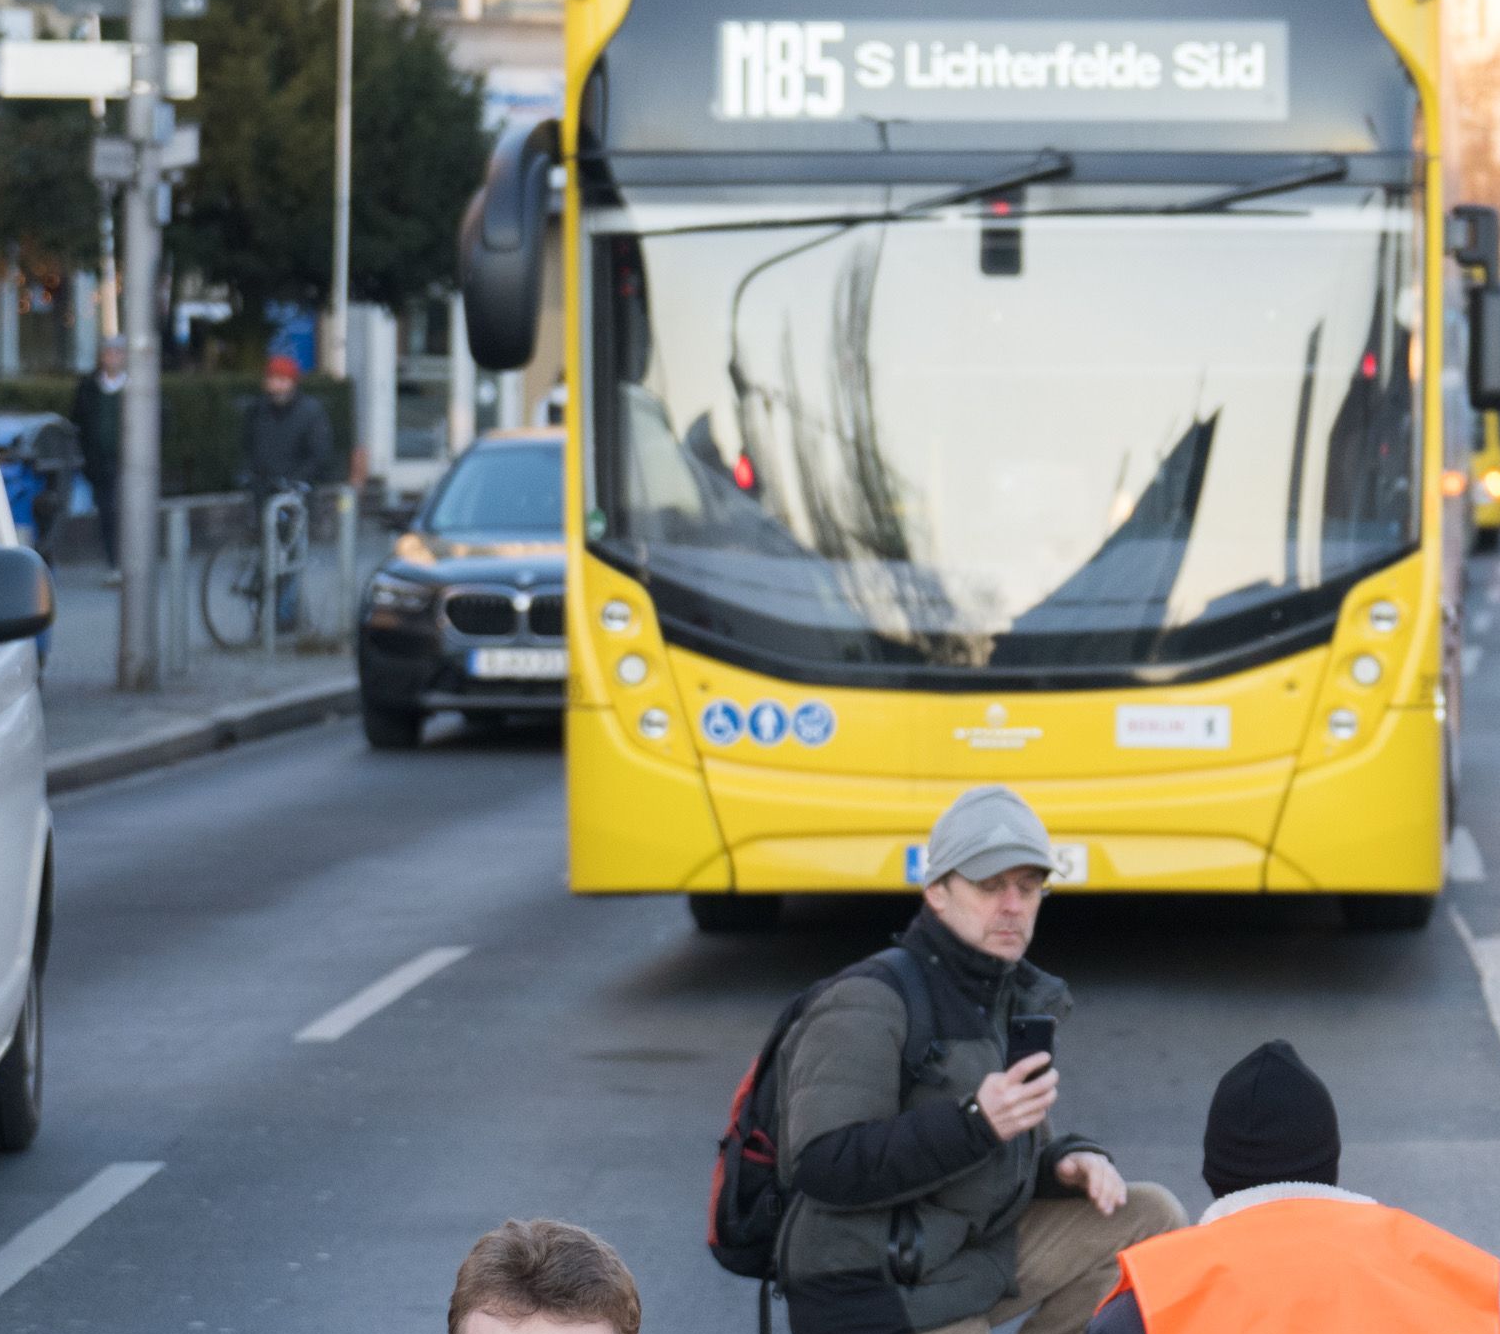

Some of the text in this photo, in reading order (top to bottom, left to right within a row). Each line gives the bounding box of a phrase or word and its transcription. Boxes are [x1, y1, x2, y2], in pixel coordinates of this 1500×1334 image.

[721, 21, 1266, 118] M85 S Lichterfelde Süd
